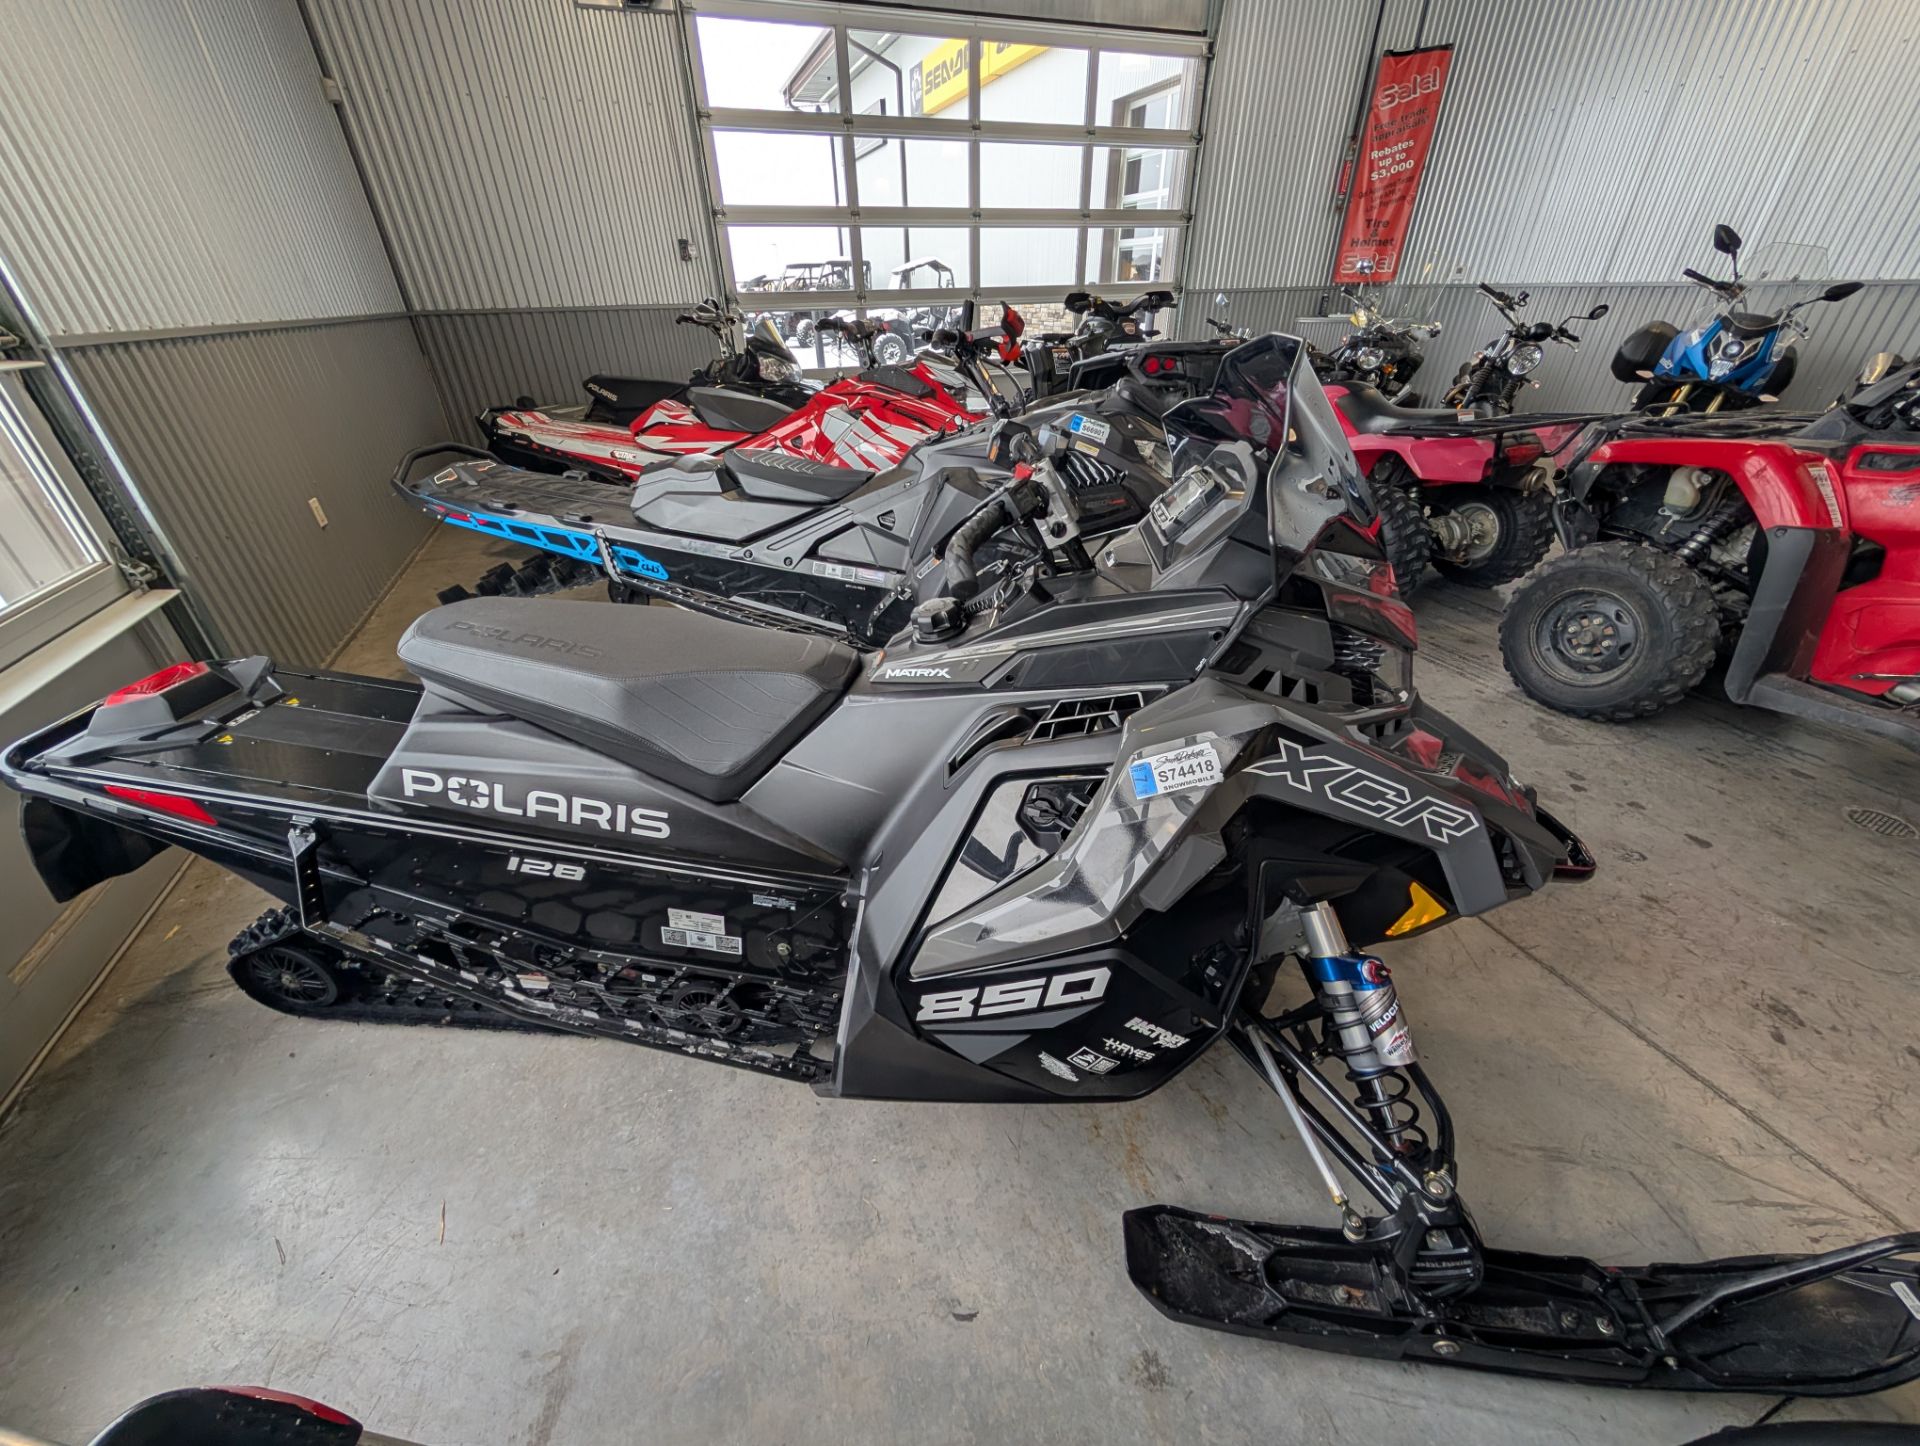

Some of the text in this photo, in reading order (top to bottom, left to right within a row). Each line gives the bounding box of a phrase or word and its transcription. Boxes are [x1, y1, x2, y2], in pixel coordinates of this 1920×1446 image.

[1378, 66, 1440, 110] Sale!
[1374, 107, 1428, 132] Free trade
[1371, 140, 1414, 160] Rebates
[1378, 152, 1406, 168] up to
[1371, 160, 1414, 181] $3,000
[1365, 218, 1390, 228] Tire
[1370, 229, 1378, 237] &
[1350, 238, 1394, 248] Helmet
[588, 382, 618, 401] POLARIS
[441, 620, 605, 658] POLARIS
[885, 667, 952, 679] MATRYX
[1158, 759, 1215, 783] S74418
[1163, 774, 1215, 791] SNOWMOBILE
[1240, 737, 1480, 844] XCR
[401, 768, 671, 839] POLARIS
[507, 856, 586, 881] 128
[915, 966, 1112, 1022] 850
[1123, 1016, 1191, 1046] FACTORY
[1102, 1037, 1156, 1060] HAYES
